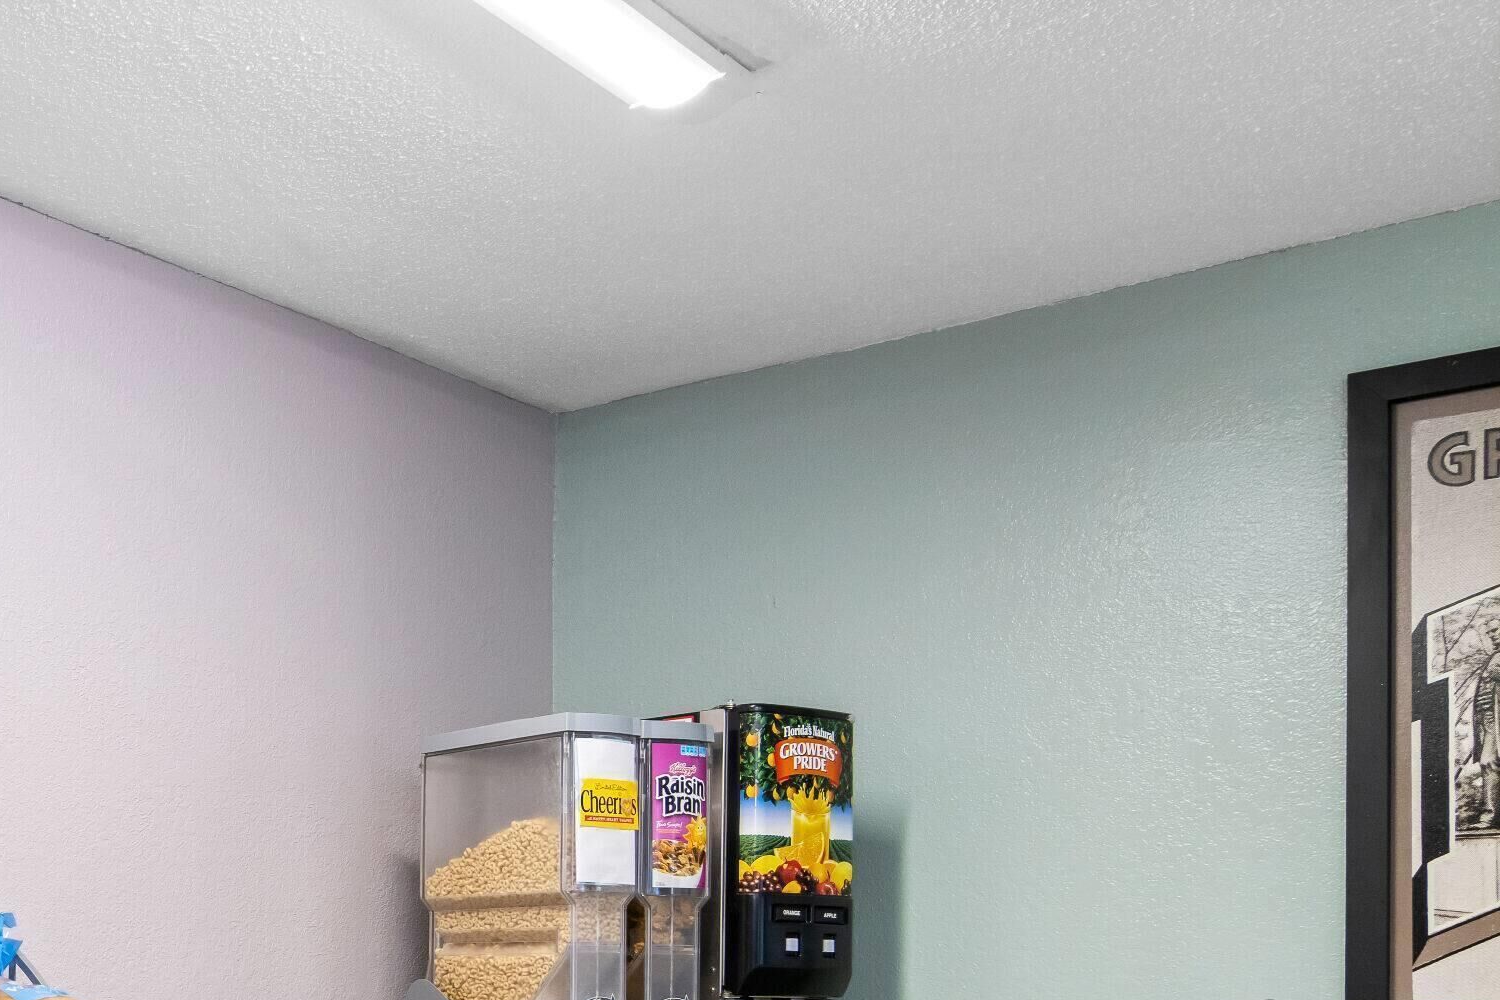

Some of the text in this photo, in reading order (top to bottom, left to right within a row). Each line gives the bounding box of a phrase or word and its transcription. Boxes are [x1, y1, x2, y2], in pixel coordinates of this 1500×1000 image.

[783, 724, 835, 742] Florida's Natural
[793, 755, 828, 773] PRIDE
[657, 775, 704, 798] Raisin
[664, 796, 701, 816] Bran
[782, 909, 802, 917] ORANGE
